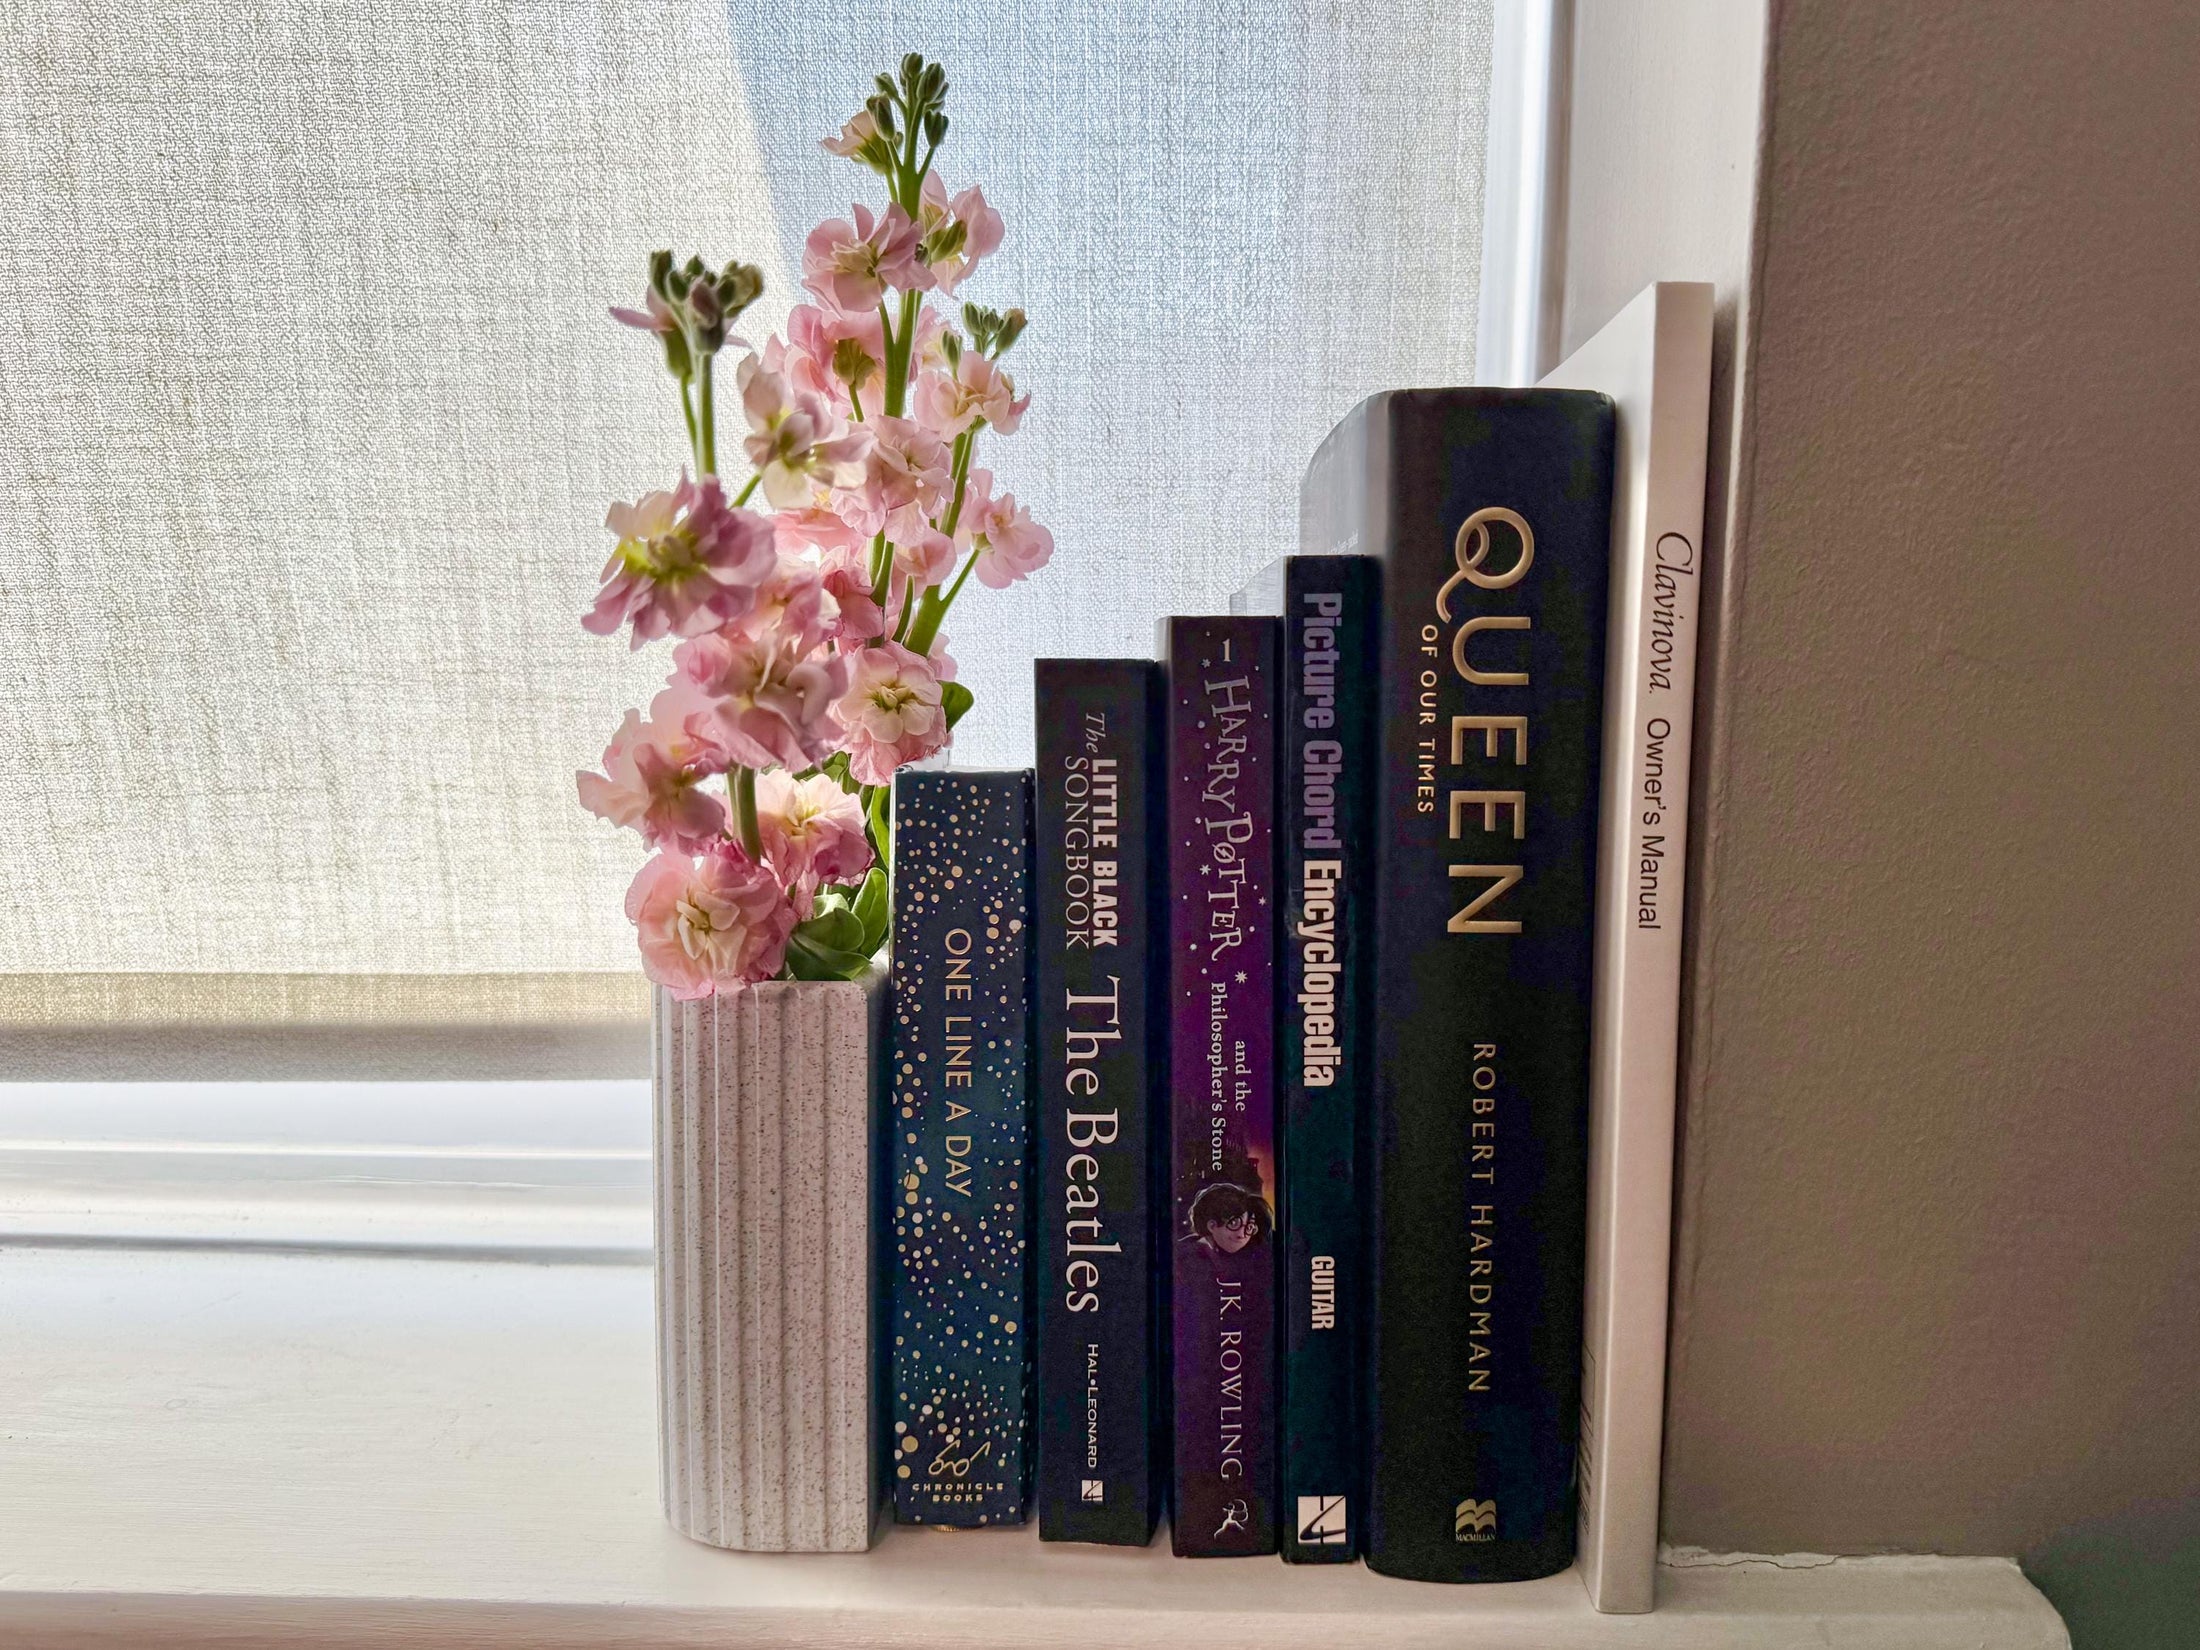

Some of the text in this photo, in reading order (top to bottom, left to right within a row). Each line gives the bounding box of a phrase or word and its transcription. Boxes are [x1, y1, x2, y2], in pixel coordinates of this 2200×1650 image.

[1202, 675, 1252, 813] HARRY
[1222, 638, 1231, 662] 1
[1417, 624, 1438, 813] OF OUR TIMES
[1436, 506, 1534, 933] QUEEN
[1065, 756, 1089, 950] SONGBOOK
[1086, 712, 1118, 946] The LITTLE BLACK
[1297, 593, 1342, 1087] Picture Chord Encyclopedia
[1642, 717, 1671, 826] Owner's
[1638, 835, 1665, 929] Manual
[945, 928, 972, 1197] ONE LINE A DAY
[1066, 975, 1122, 1312] The Beatles
[1207, 982, 1228, 1171] Philosopher's Stone
[1235, 1040, 1251, 1112] and the
[1311, 1256, 1335, 1330] GUITAR
[1468, 1043, 1497, 1391] ROBERT HARDMAN
[1217, 1277, 1242, 1479] J.K. ROWLING
[912, 1482, 1005, 1492] CHRONICLE
[932, 1494, 984, 1502] BOOKS
